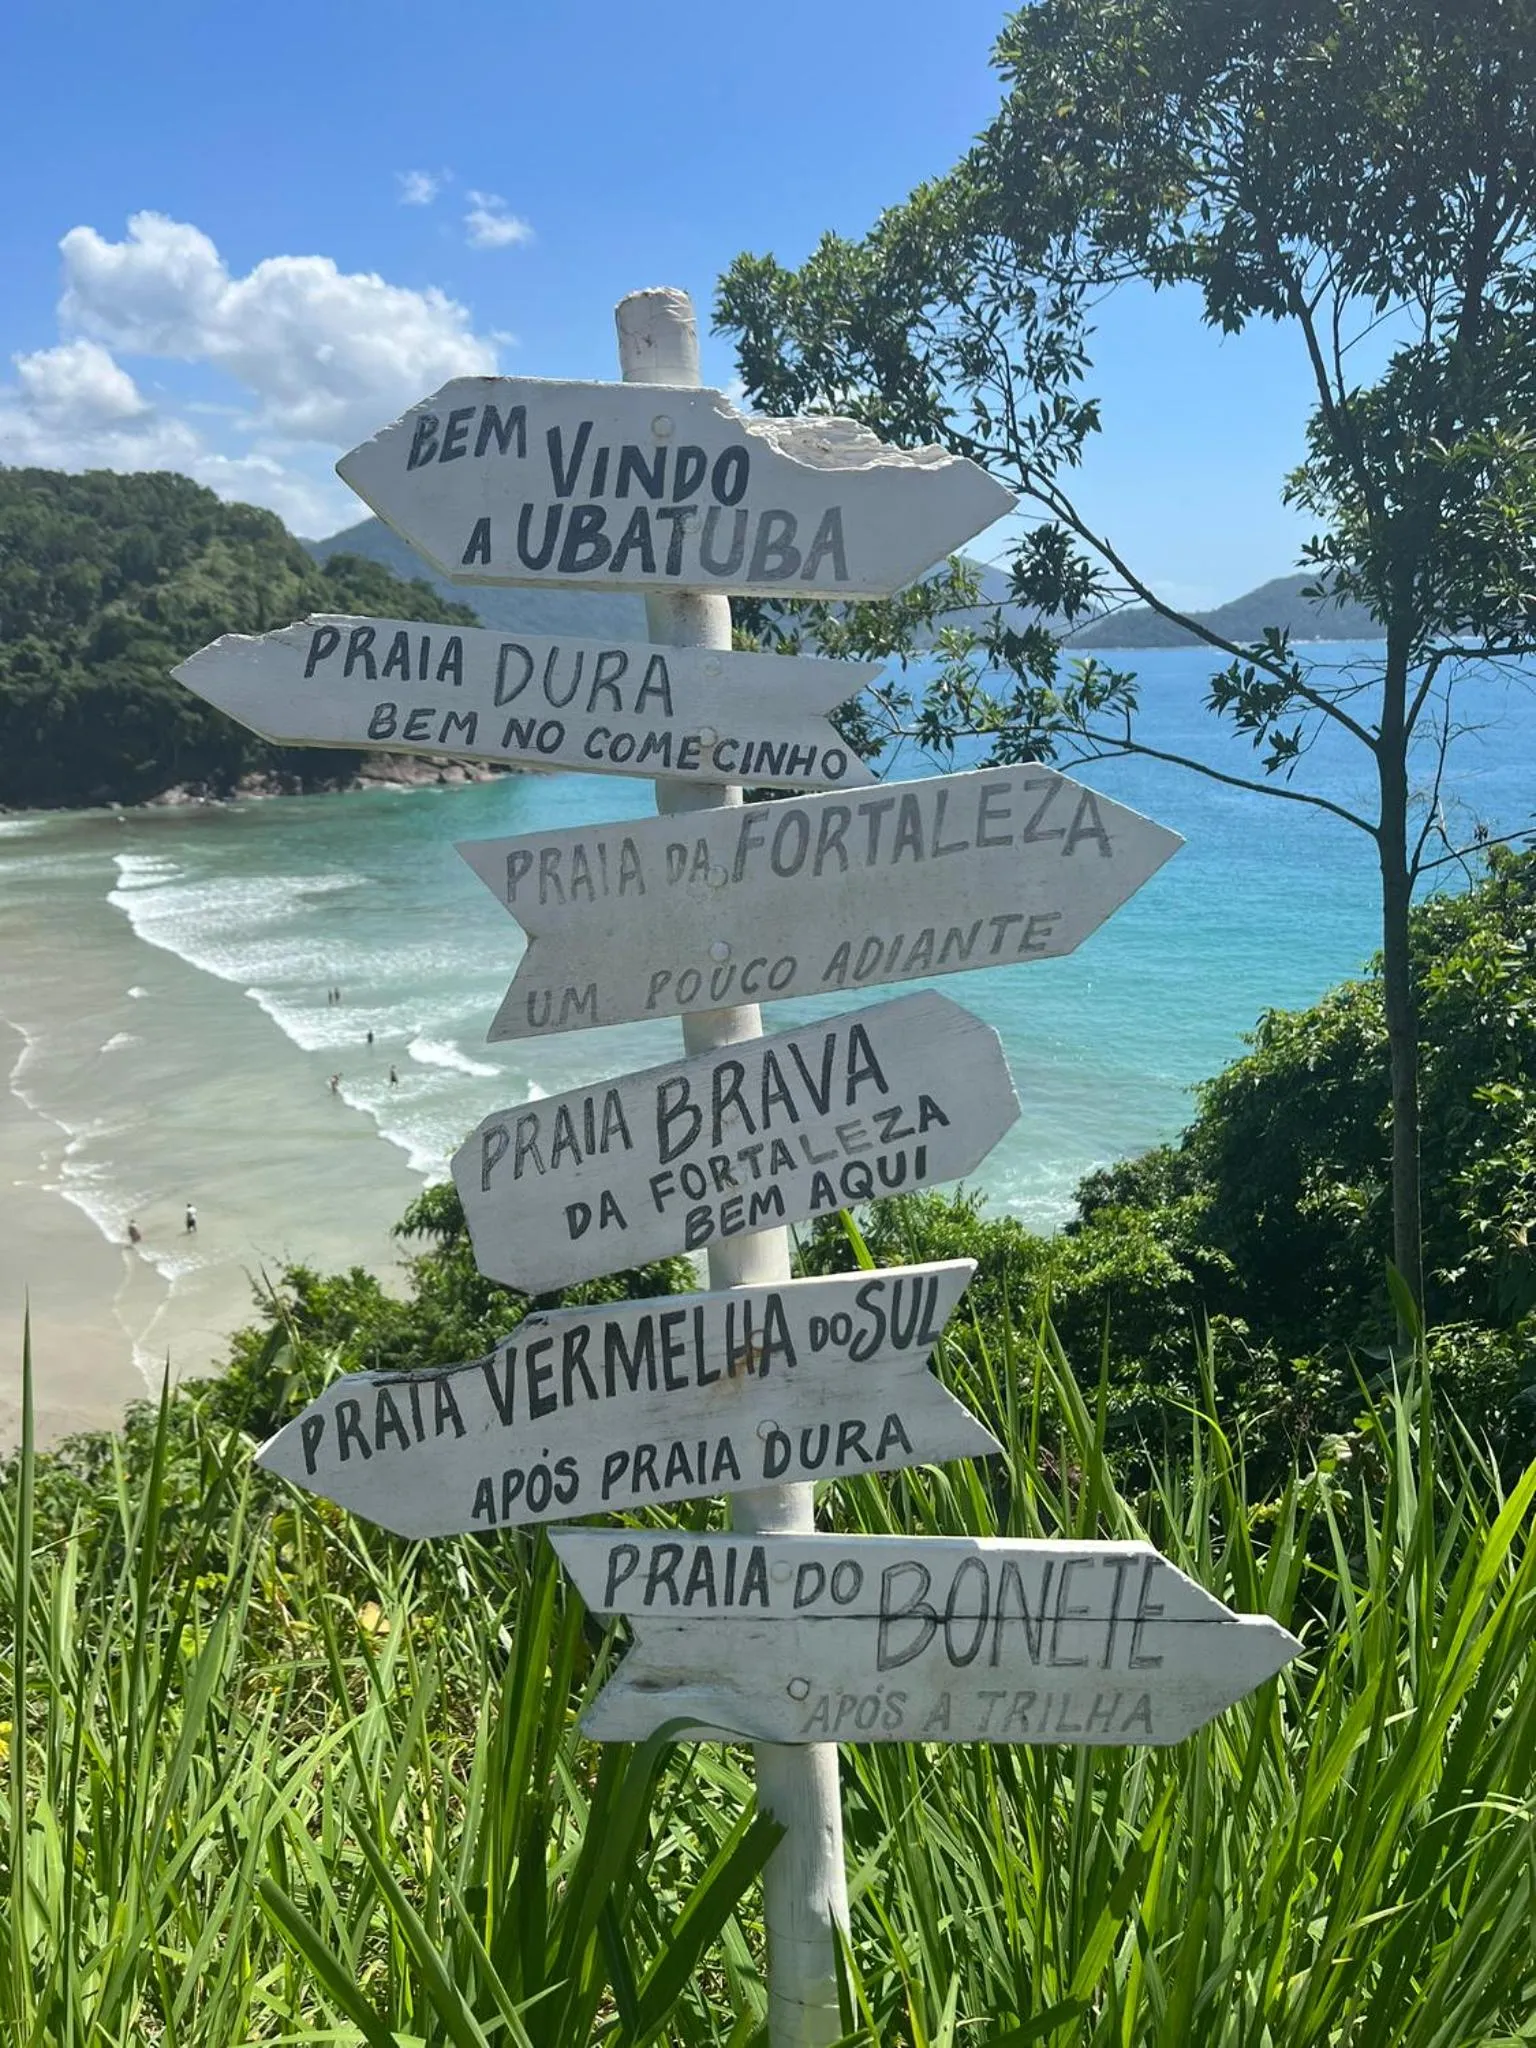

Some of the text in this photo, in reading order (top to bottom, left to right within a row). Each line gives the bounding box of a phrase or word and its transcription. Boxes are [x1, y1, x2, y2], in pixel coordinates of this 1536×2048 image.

[407, 405, 750, 506] BEM VINDO
[461, 503, 848, 582] A UBATUBA
[304, 625, 673, 717] PRAIA DURA
[367, 703, 847, 780] BEM NO COMECINHO
[506, 779, 1113, 905] PRAIA DA FORTALEZA
[527, 912, 1062, 1027] UM POUCO ADIANTE
[481, 1024, 889, 1191] PRAIA BRAVA
[565, 1095, 950, 1240] DA FORTALEZA
[685, 1145, 927, 1251] BEM AQUI
[301, 1276, 938, 1475] PRAIA VERMELHA DO SUL
[471, 1413, 913, 1524] APÓS PRAIA DURA
[604, 1542, 1165, 1672] PRAIA DO BONETE
[802, 1684, 1153, 1734] APÓS A TRILHA
